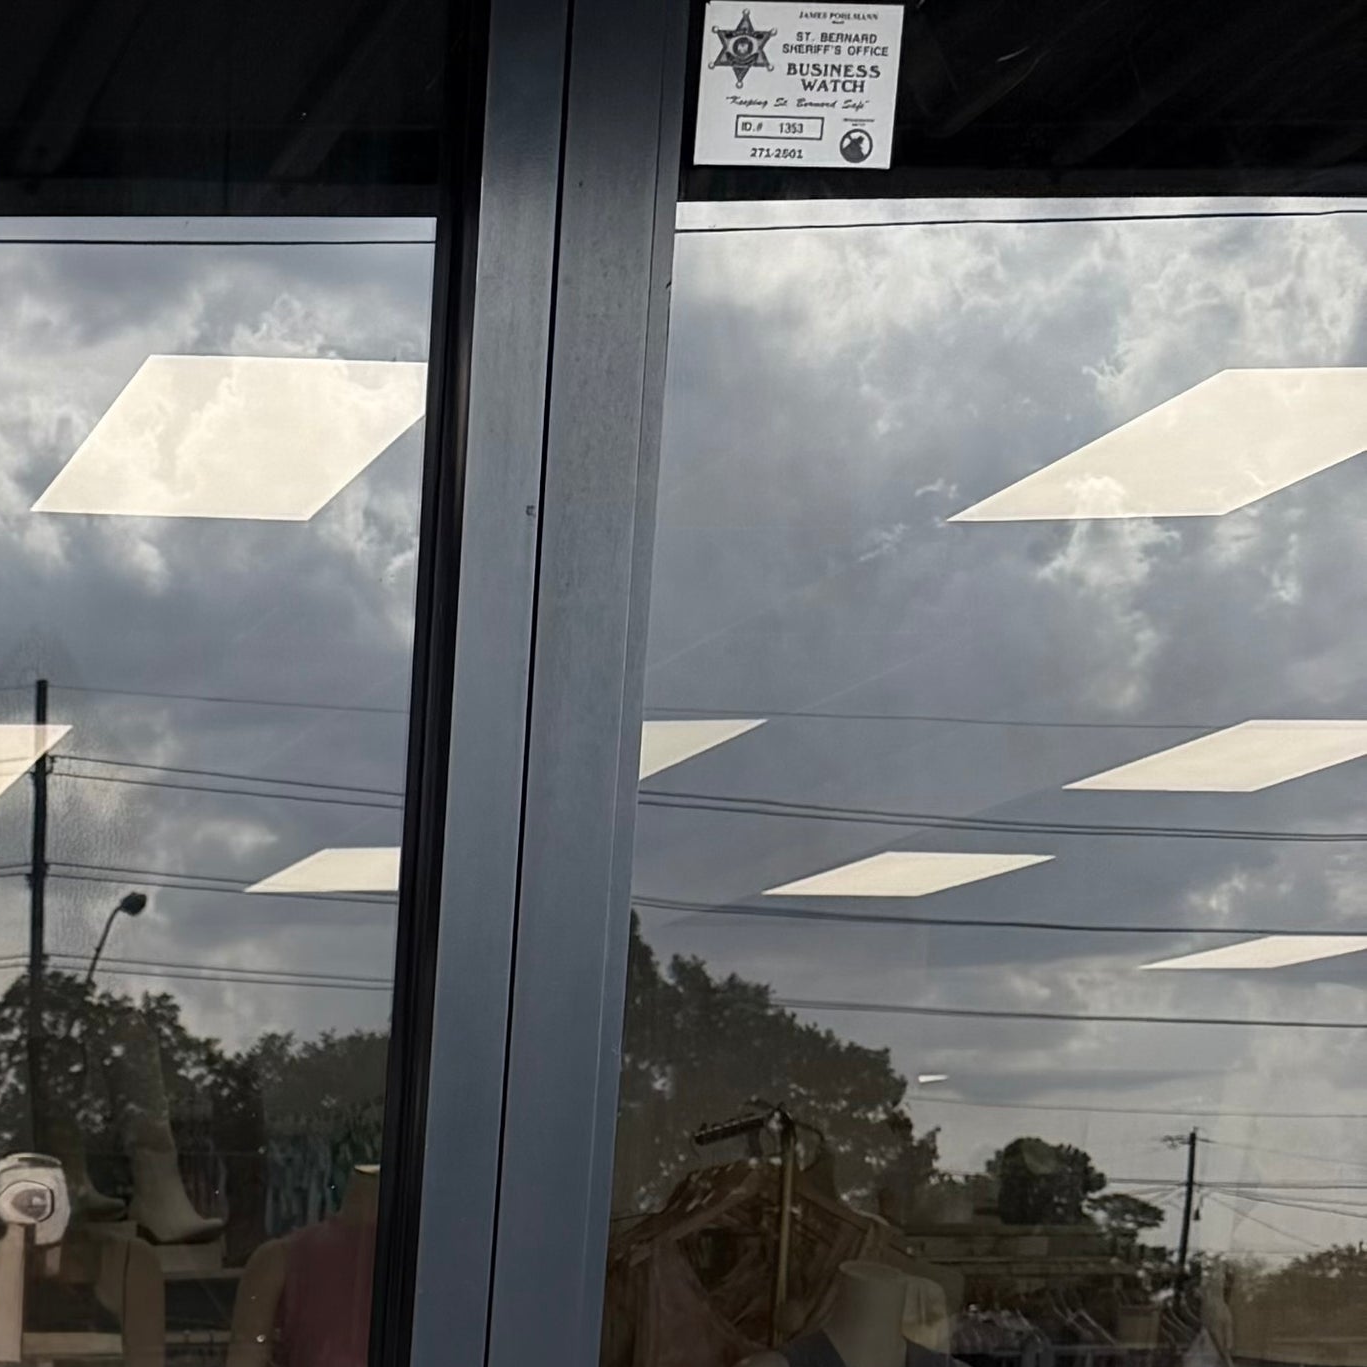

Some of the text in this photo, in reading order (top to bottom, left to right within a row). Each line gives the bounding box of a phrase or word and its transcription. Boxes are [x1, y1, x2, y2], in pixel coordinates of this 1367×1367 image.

[820, 32, 877, 44] BERNARD
[782, 43, 889, 57] SHERIFF'S OFFICE
[787, 62, 881, 79] BUSINESS
[801, 78, 865, 93] WATCH
